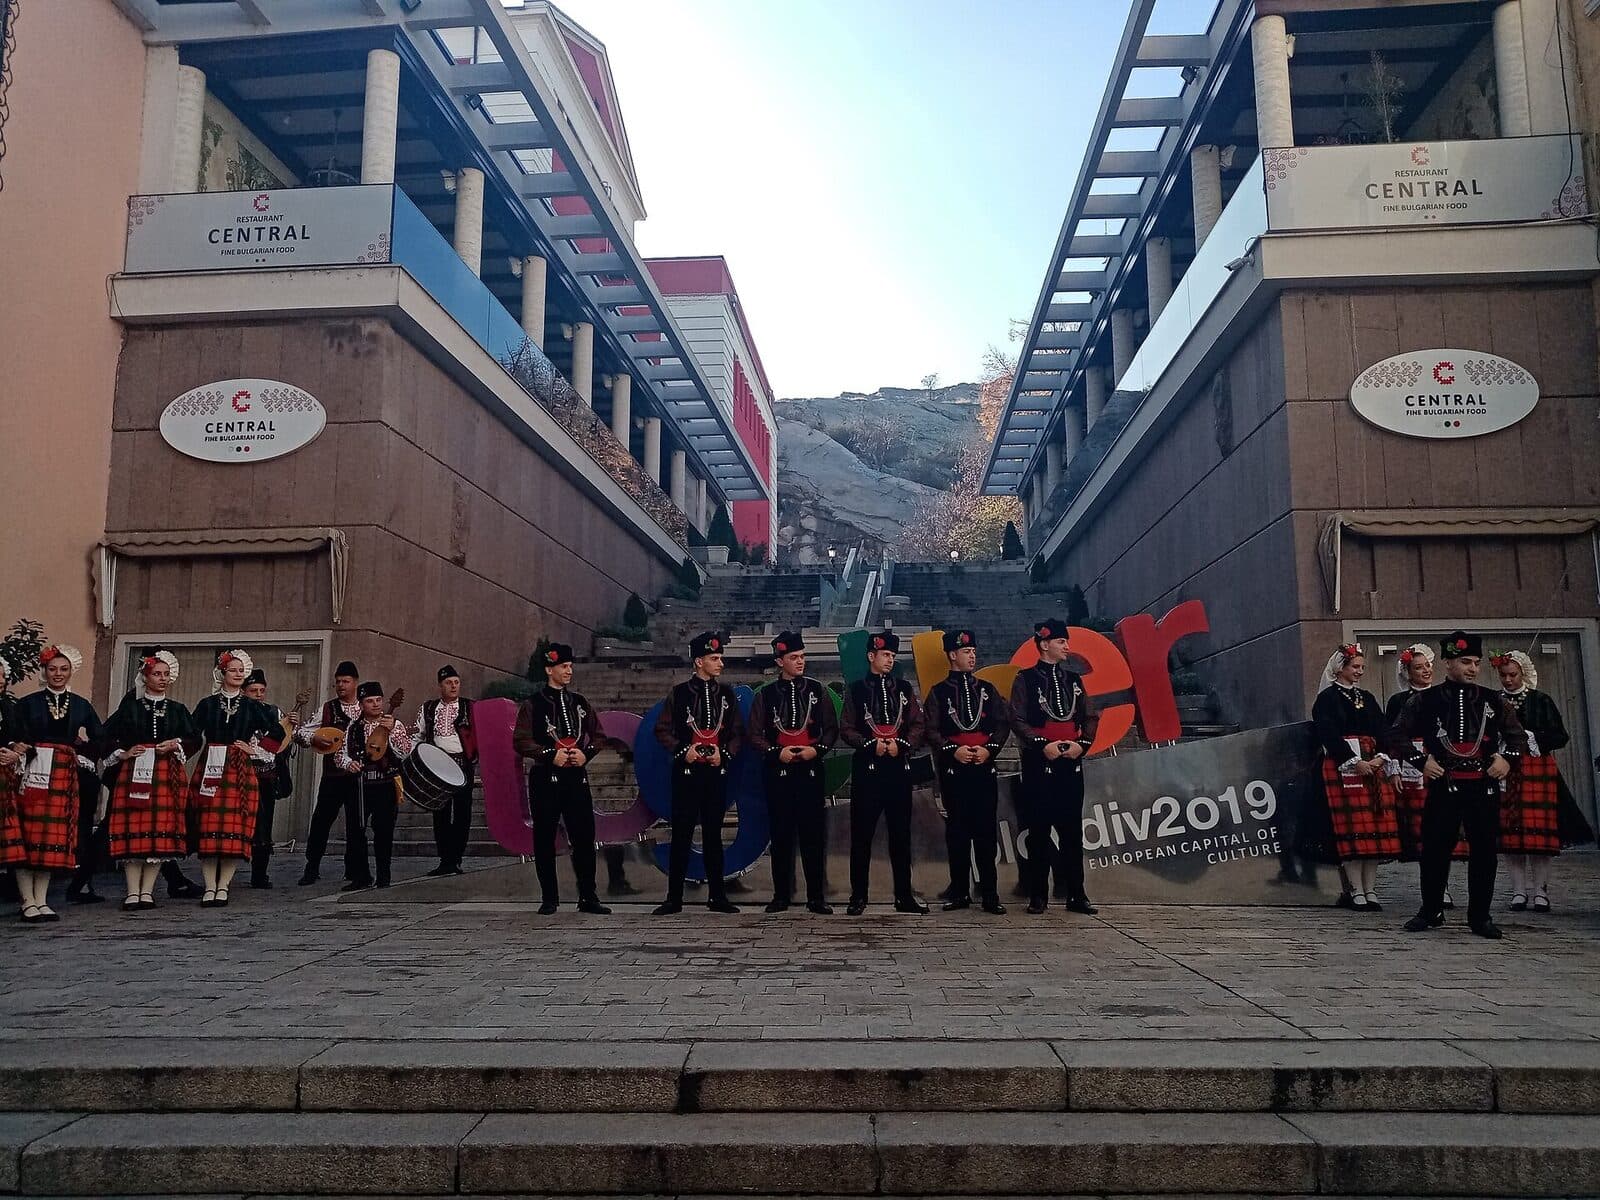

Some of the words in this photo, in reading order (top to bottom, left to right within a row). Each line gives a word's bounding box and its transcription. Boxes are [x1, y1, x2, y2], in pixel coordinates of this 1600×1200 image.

[1394, 168, 1448, 178] RESTAURANT
[1365, 179, 1483, 199] CENTRAL
[1401, 203, 1445, 211] BULGARIAN
[1446, 202, 1468, 210] FOOD
[236, 214, 284, 223] RESTAURANT
[208, 225, 310, 244] CENTRAL
[236, 247, 275, 255] BULGARIAN
[1405, 394, 1487, 407] CENTRAL
[1423, 408, 1465, 416] BULGARIAN
[205, 420, 276, 433] CENTRAL
[968, 779, 1277, 883] ldiv2019
[1088, 844, 1177, 870] EUROPEAN
[1180, 832, 1250, 854] CAPITAL
[1257, 826, 1279, 841] OF
[1207, 842, 1282, 865] CULTURE
